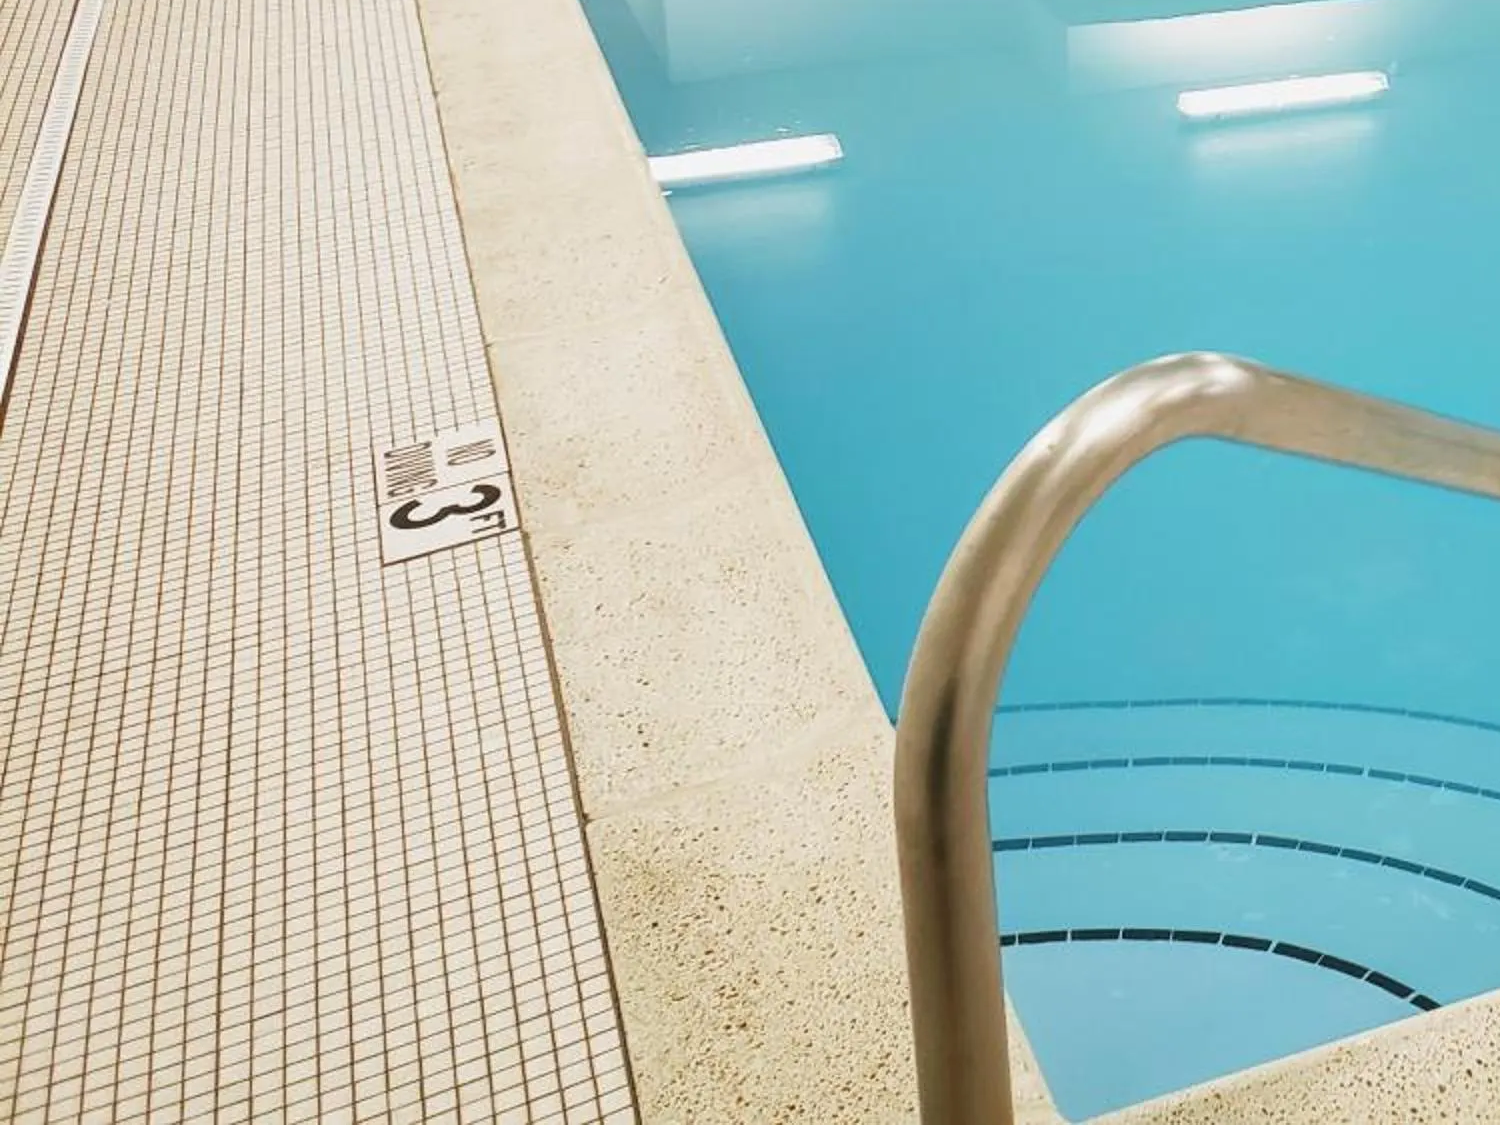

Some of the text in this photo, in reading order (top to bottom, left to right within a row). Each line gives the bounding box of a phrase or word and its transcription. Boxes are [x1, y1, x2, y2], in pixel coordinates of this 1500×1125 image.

[447, 438, 497, 466] NO
[389, 484, 507, 534] 3 FT
